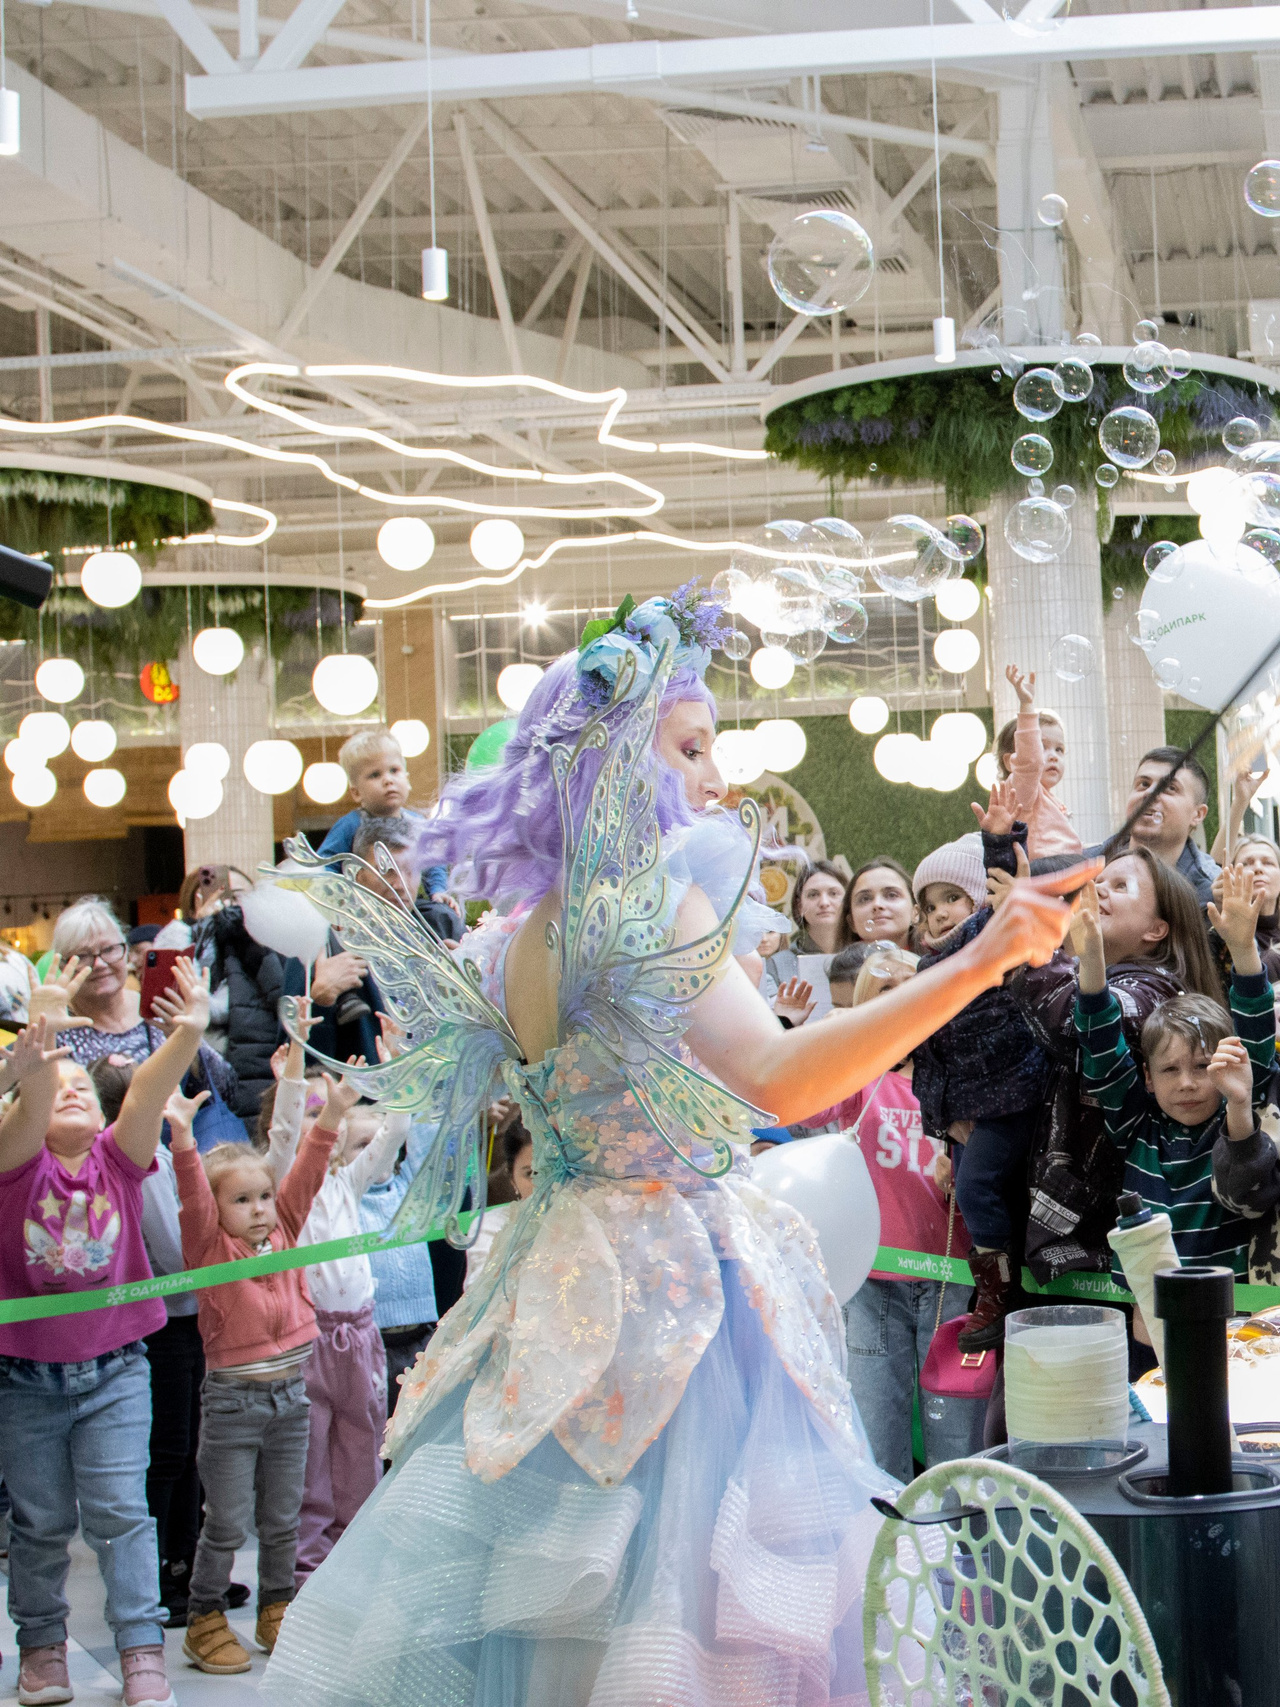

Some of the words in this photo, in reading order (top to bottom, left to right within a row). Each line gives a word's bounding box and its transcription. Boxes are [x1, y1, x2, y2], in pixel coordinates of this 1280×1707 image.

[1157, 613, 1206, 636] ОДИПАРК
[880, 1106, 923, 1129] SEVE
[897, 1256, 939, 1274] ОДИПАРК
[130, 1276, 194, 1297] ОДИПАРК
